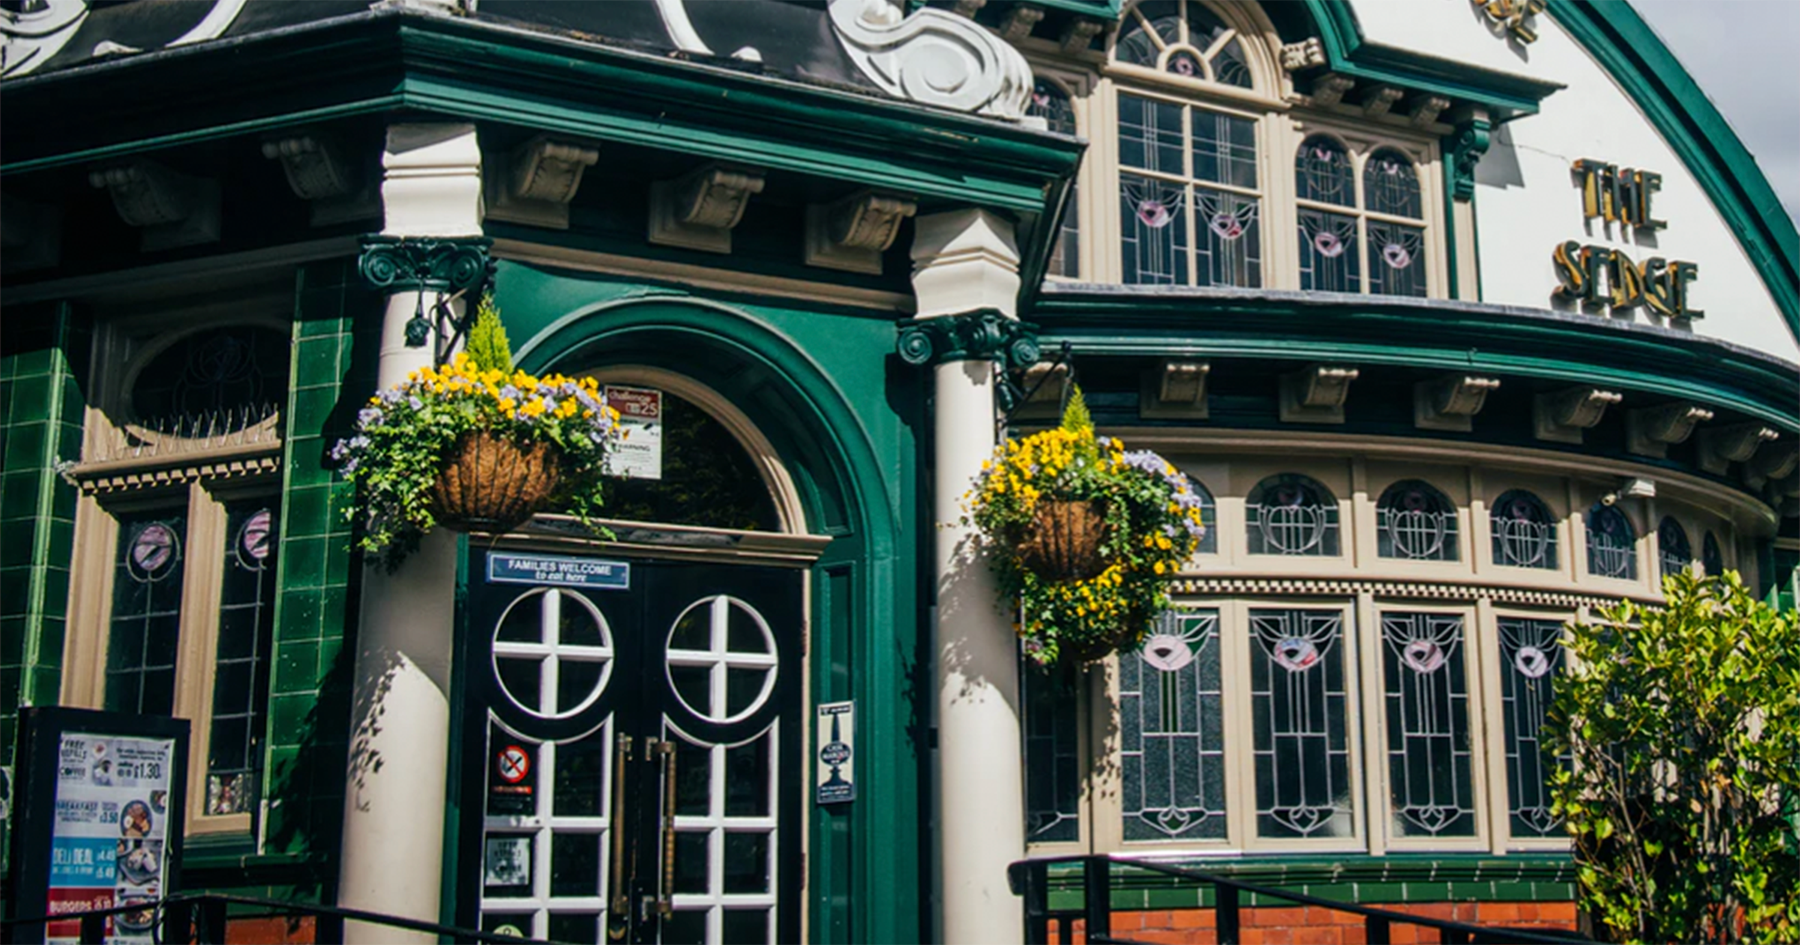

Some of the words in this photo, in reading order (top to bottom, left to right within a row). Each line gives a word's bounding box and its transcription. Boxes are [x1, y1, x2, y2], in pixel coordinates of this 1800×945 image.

[1572, 158, 1668, 231] THE
[1551, 240, 1705, 322] SEDGE
[641, 402, 658, 416] 25
[508, 559, 557, 572] FAMILIES
[558, 562, 612, 575] WELCOME
[535, 571, 546, 580] to
[547, 572, 564, 581] eat
[565, 573, 587, 582] here
[52, 847, 71, 865] DELI
[73, 847, 94, 865] DEAL
[49, 900, 92, 913] BURGERS
